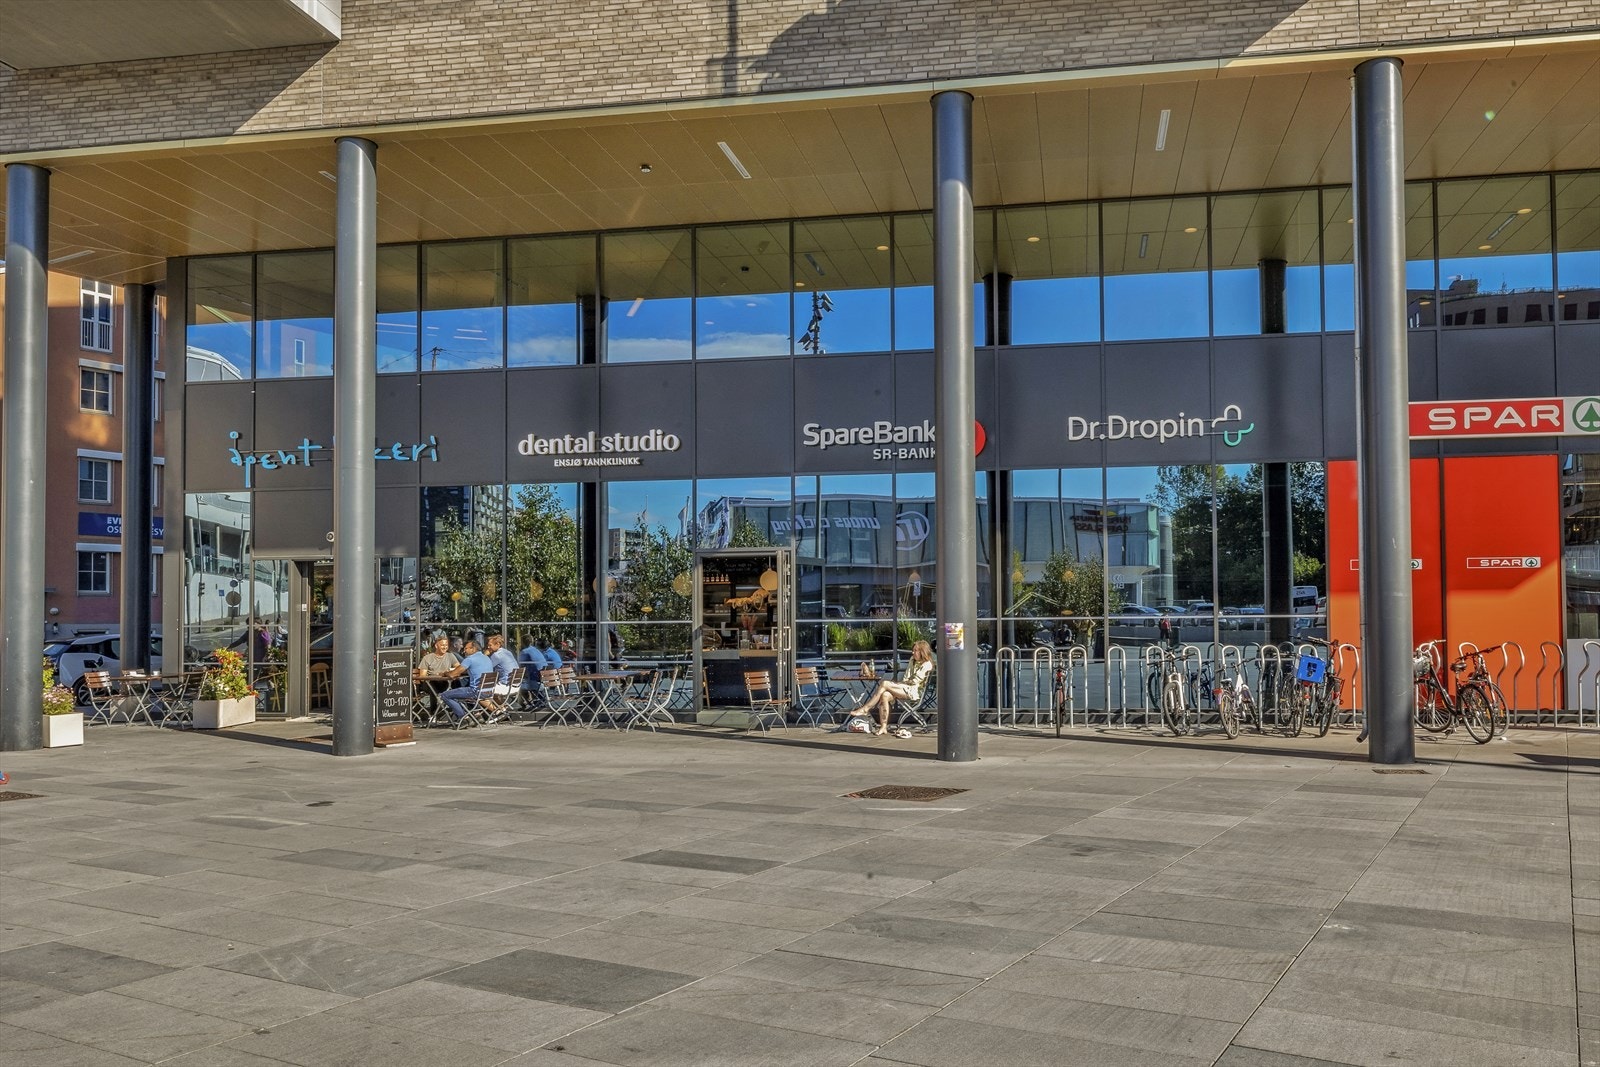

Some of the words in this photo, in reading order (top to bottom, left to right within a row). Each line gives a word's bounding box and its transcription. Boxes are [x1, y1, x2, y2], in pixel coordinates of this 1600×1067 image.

[1068, 411, 1204, 444] Dr.Dropin
[1428, 404, 1561, 431] SPAR
[518, 431, 596, 456] dental
[601, 429, 681, 453] studio
[803, 419, 936, 450] SpareBank
[229, 431, 323, 488] åpent
[554, 458, 582, 467] ENSJØ
[583, 456, 640, 467] TANNKLINIKK
[872, 447, 936, 461] SR-BANK
[1480, 559, 1521, 567] SPAR
